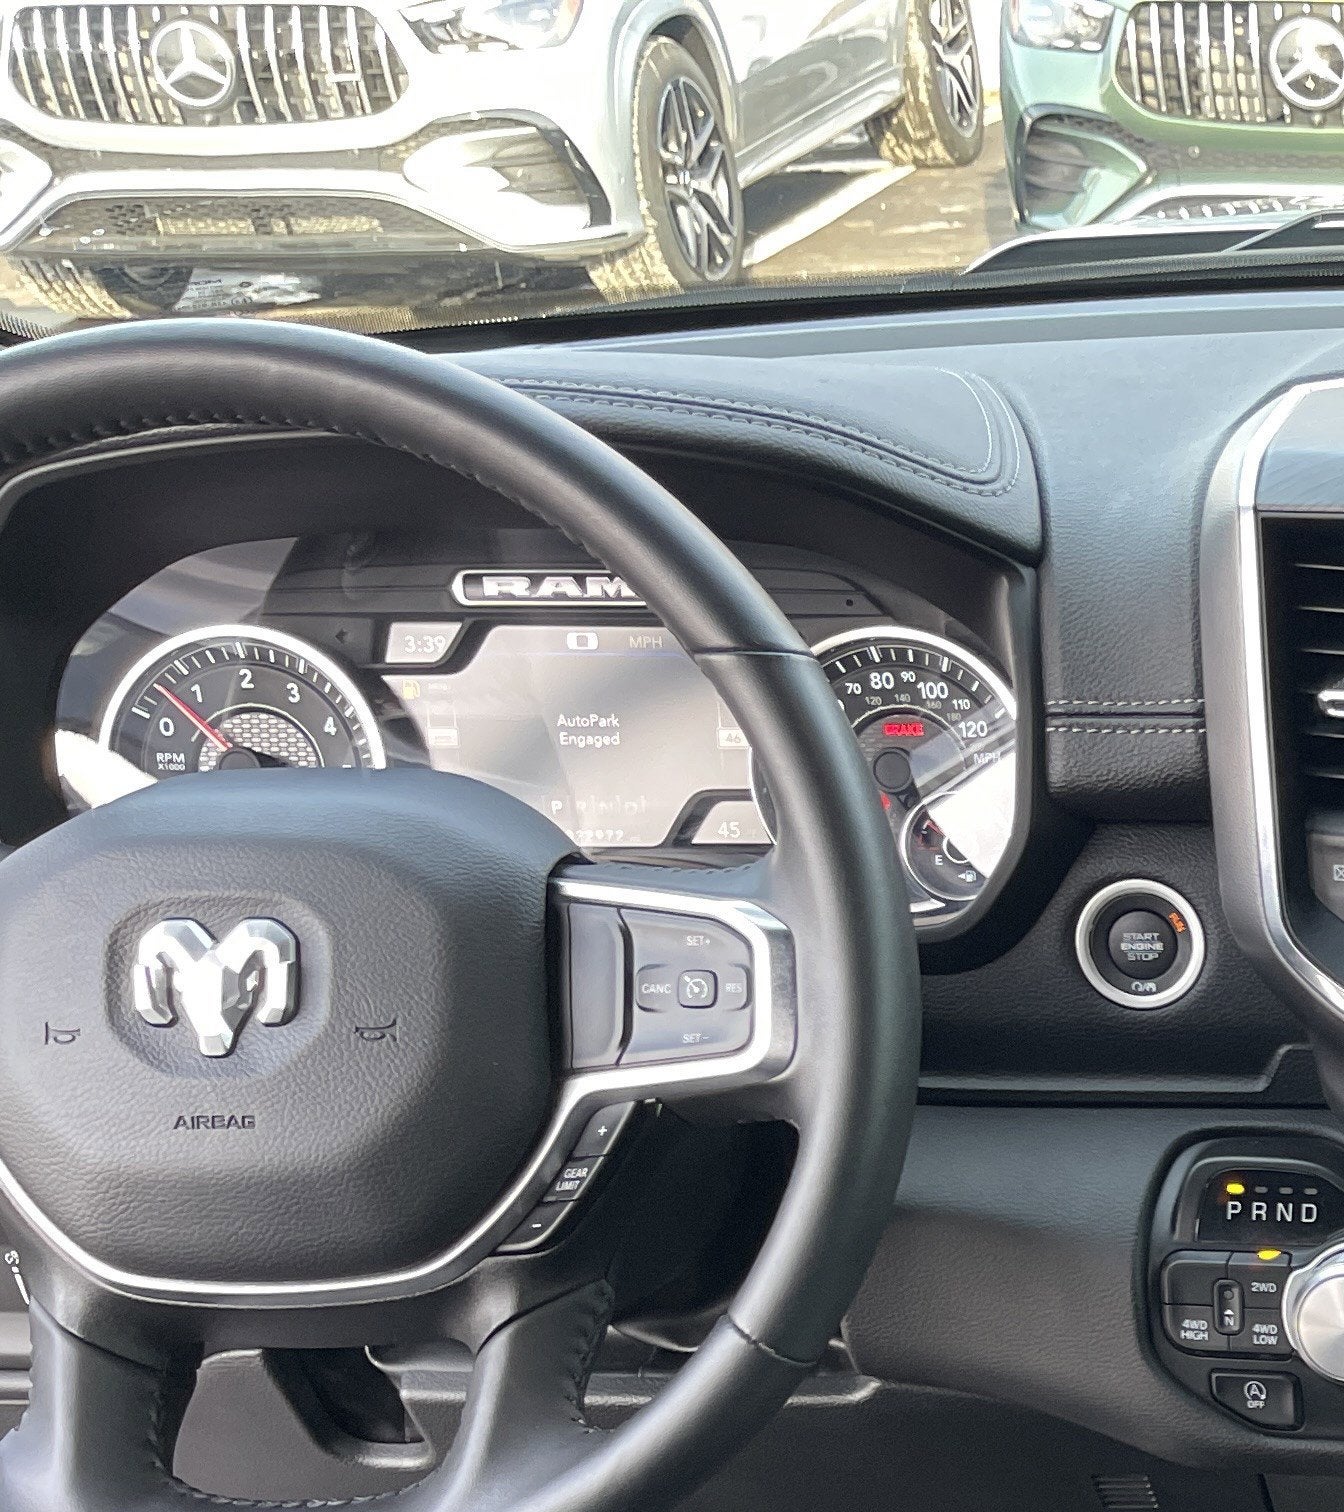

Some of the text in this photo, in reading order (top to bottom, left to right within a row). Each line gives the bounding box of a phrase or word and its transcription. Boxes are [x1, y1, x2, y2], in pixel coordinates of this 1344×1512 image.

[482, 575, 637, 598] RAM
[404, 634, 446, 653] 3:39
[629, 635, 663, 650] MPH
[238, 668, 255, 689] 2
[869, 672, 895, 690] 80
[901, 671, 916, 683] 90
[191, 683, 203, 703] 1
[287, 682, 301, 704] 3
[845, 682, 862, 695] 70
[917, 682, 949, 700] 100
[952, 699, 971, 711] 110
[159, 717, 175, 737] 0
[323, 716, 337, 736] 4
[557, 714, 620, 728] AutoPark
[883, 723, 924, 737] BRAKE
[958, 720, 988, 739] 120
[559, 732, 621, 748] Engaged
[156, 752, 185, 763] RPM
[717, 821, 741, 838] 45
[934, 854, 943, 866] E
[1122, 932, 1160, 941] START
[1121, 942, 1164, 951] ENGINE
[1127, 952, 1159, 961] STOP
[641, 983, 672, 994] CANC
[725, 983, 743, 993] RES
[173, 1114, 256, 1130] AIRBAG
[564, 1167, 589, 1179] GEAR
[556, 1180, 581, 1191] LIMIT
[1227, 1201, 1318, 1223] P R N D
[1251, 1282, 1277, 1293] 2WD
[1181, 1318, 1209, 1330] 4WD
[1225, 1315, 1235, 1327] N
[1181, 1329, 1209, 1341] HIGH
[1252, 1323, 1278, 1335] 4WD
[1253, 1334, 1279, 1346] LOW
[1247, 1398, 1265, 1410] OFF
